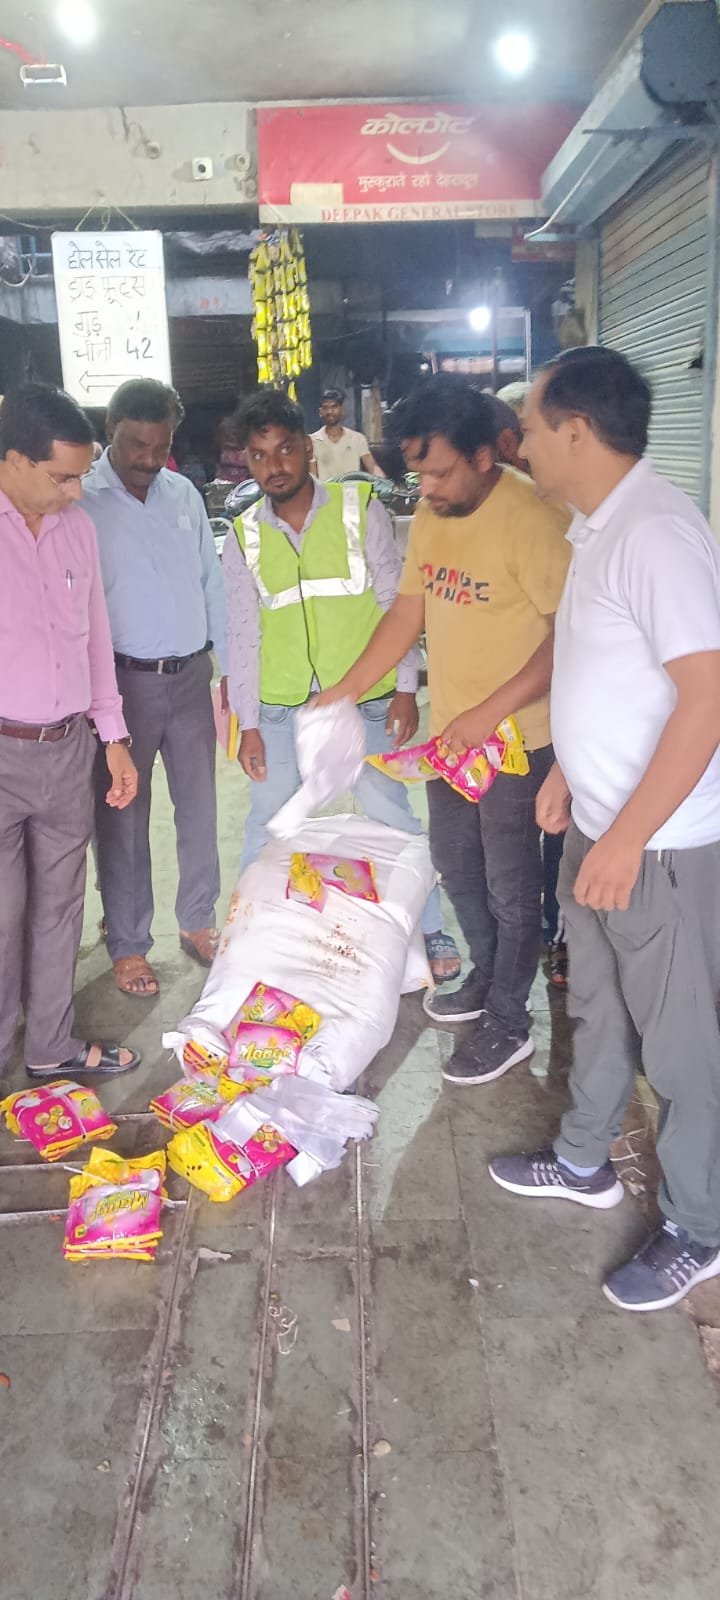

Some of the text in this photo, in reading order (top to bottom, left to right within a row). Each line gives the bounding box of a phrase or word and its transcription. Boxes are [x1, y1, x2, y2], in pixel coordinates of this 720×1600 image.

[360, 112, 476, 135] कोलगेट
[357, 172, 406, 193] मुस्कुराते
[410, 172, 431, 189] रहो
[321, 207, 383, 222] DEEPAK
[387, 206, 461, 220] GENERAL
[125, 336, 154, 361] 42
[239, 1041, 292, 1065] Mango
